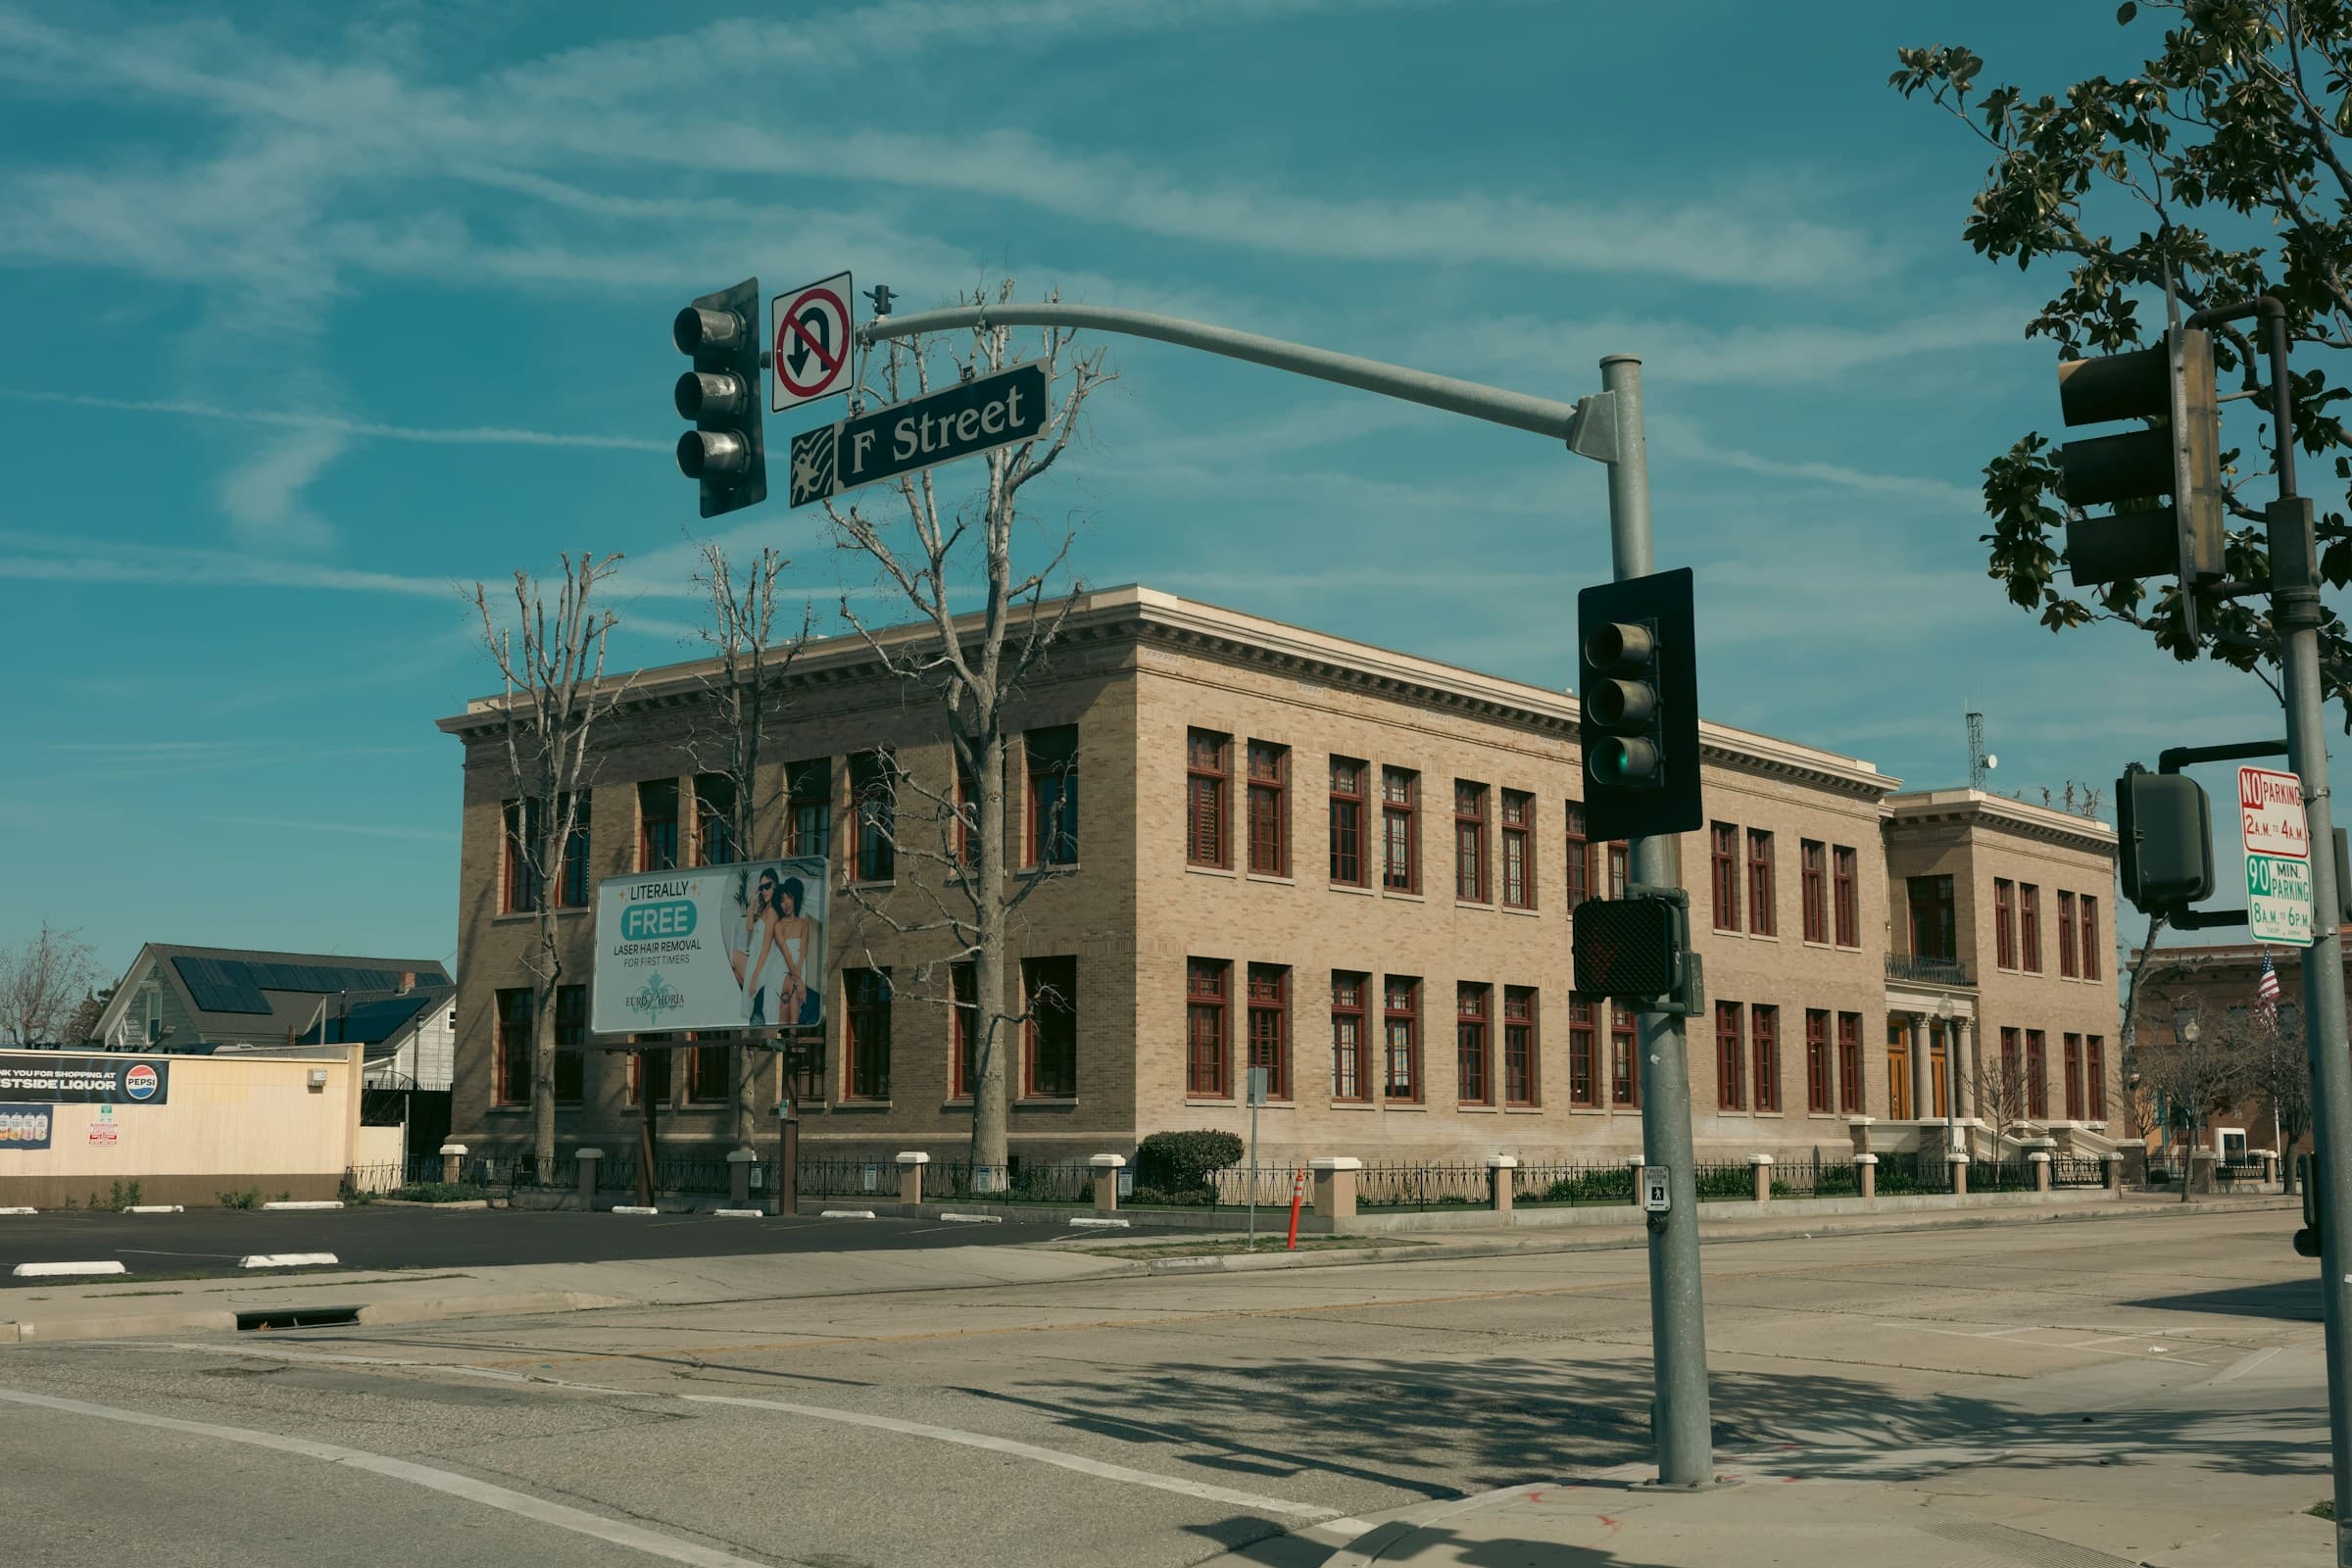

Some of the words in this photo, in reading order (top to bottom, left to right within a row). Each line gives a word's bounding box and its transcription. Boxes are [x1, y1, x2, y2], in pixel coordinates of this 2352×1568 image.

[852, 429, 876, 474] F
[893, 384, 1026, 463] Street
[2240, 771, 2263, 806] NO
[2263, 781, 2302, 807] PARKING
[2249, 858, 2270, 892] 90
[2277, 862, 2301, 879] MIN.
[630, 880, 689, 901] LITERALLY
[2272, 878, 2310, 903] PARKING
[628, 906, 688, 936] FREE
[613, 944, 639, 956] LASER
[640, 942, 660, 955] HAIR
[661, 939, 702, 954] REMOVAL
[623, 957, 639, 968] FOR
[640, 956, 661, 967] FIRST
[662, 954, 690, 965] TIMERS
[55, 1070, 103, 1079] SHOPPING
[59, 1079, 117, 1091] LIQUOR
